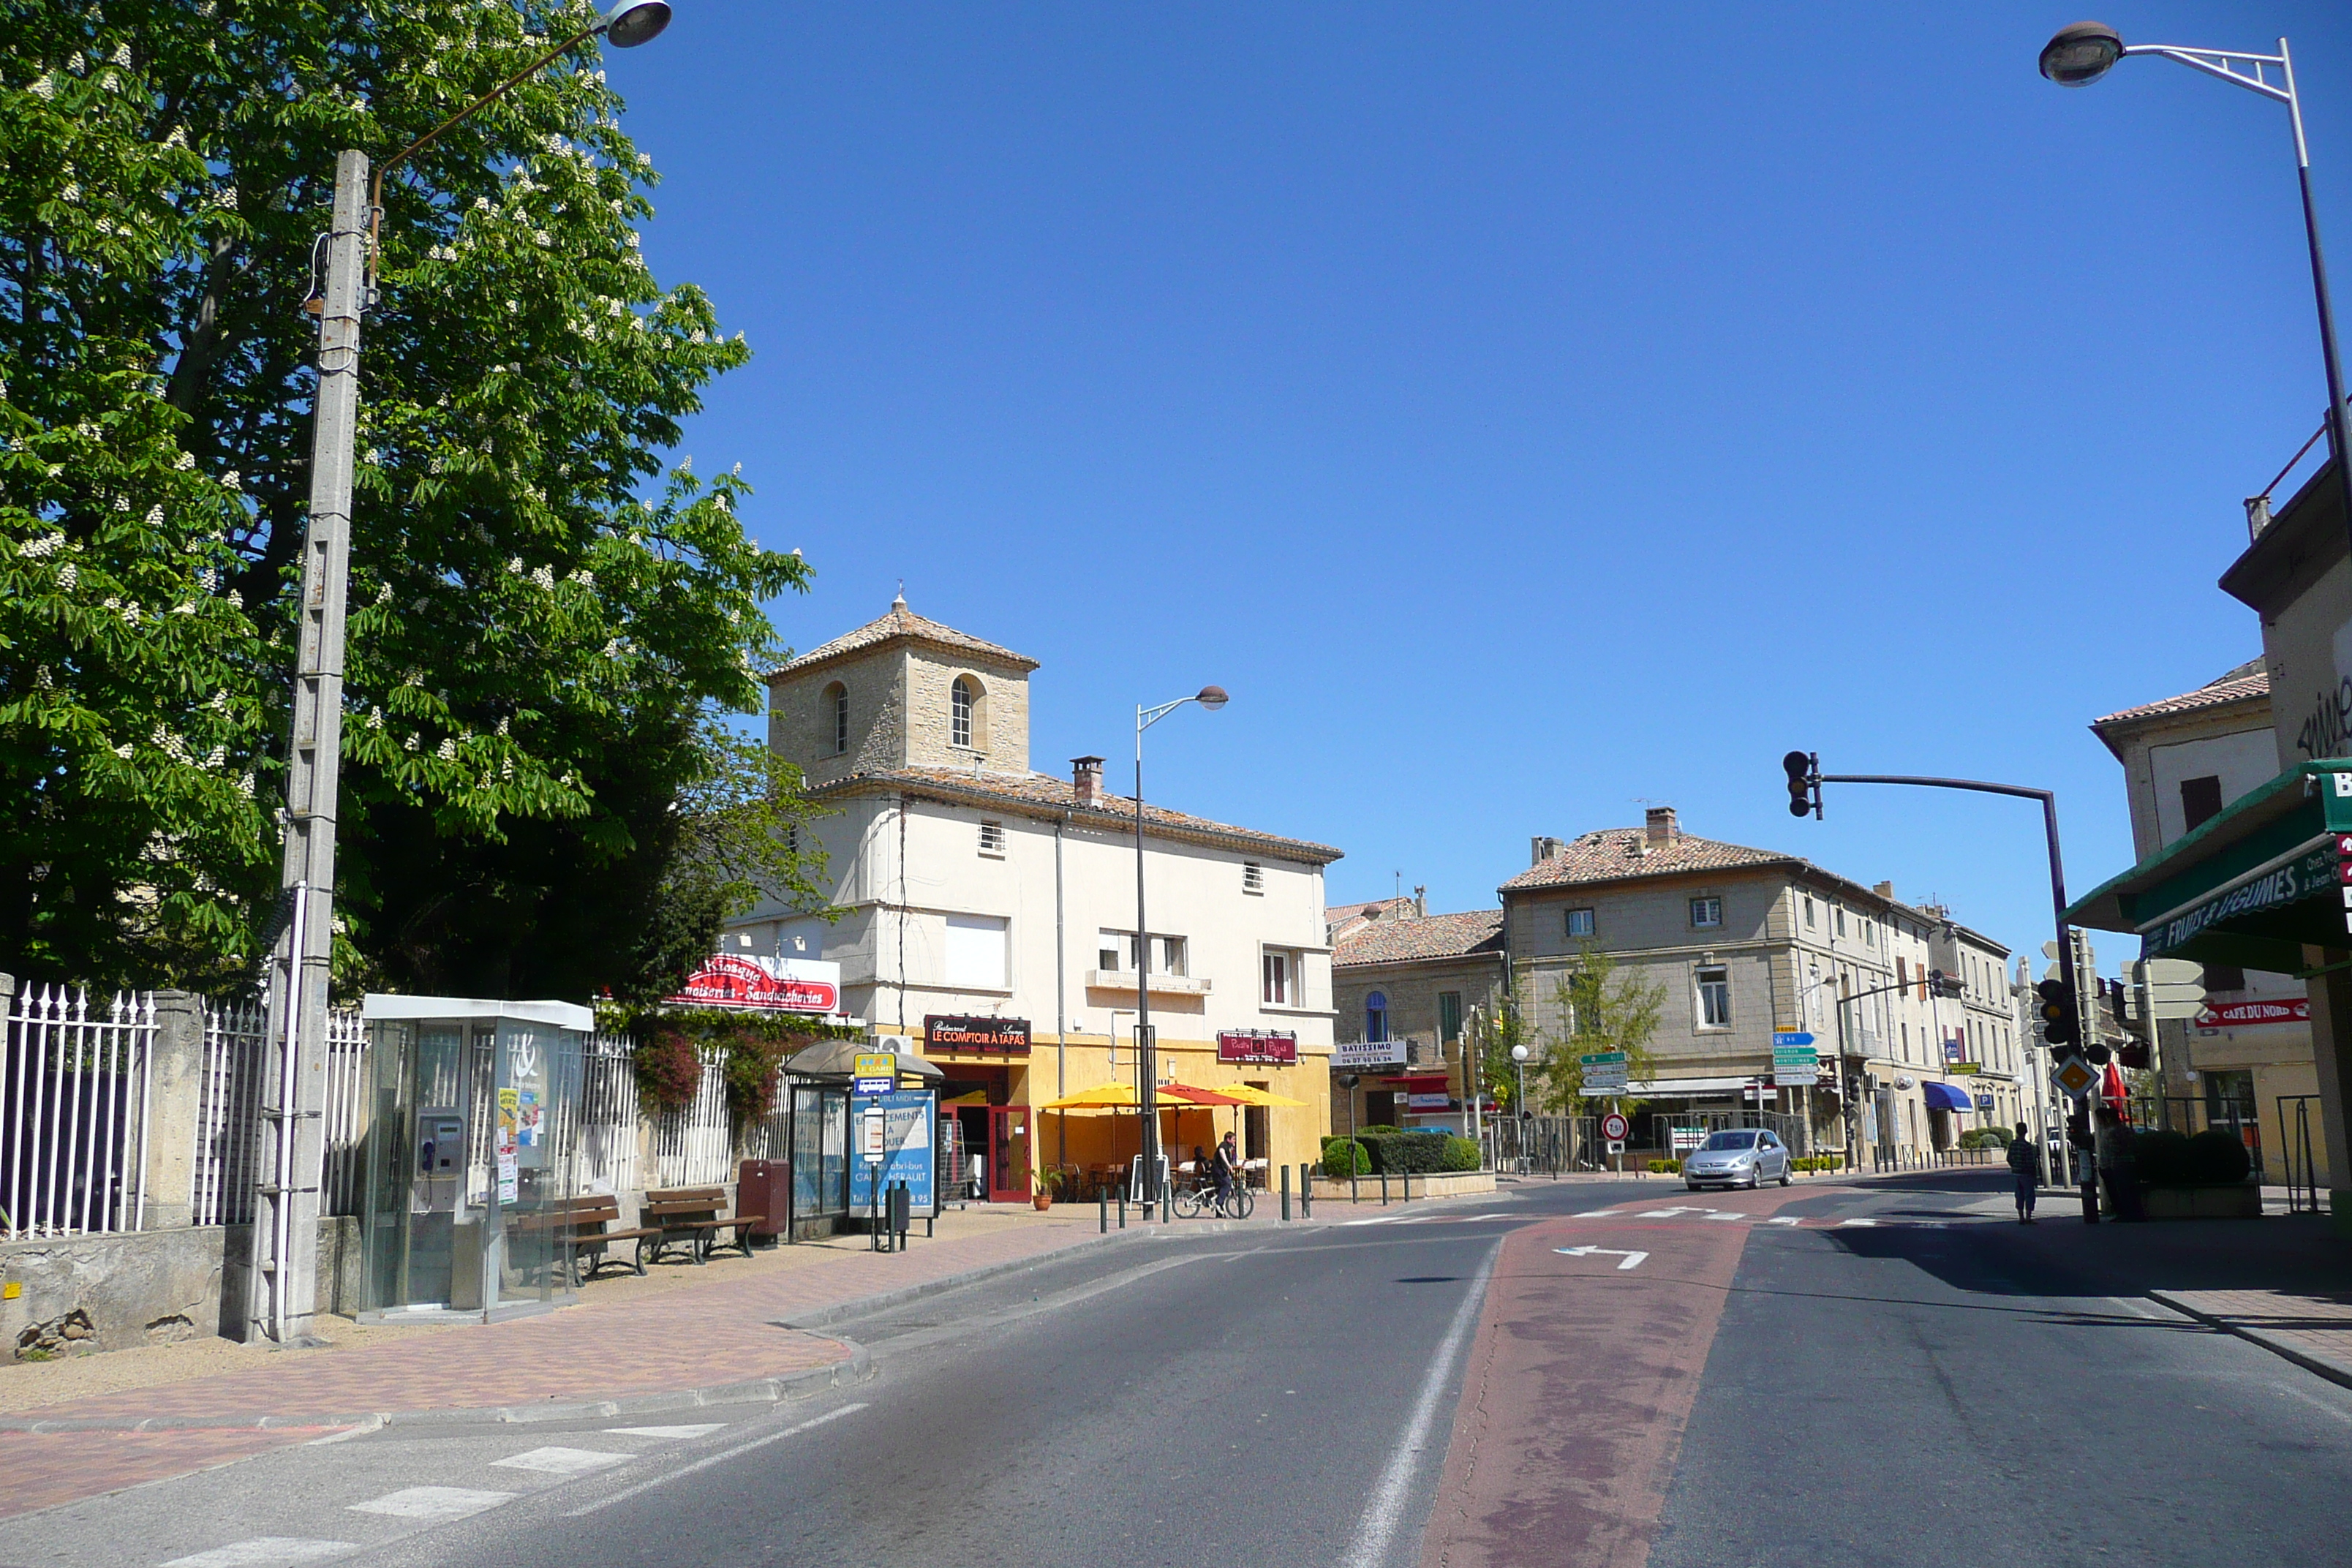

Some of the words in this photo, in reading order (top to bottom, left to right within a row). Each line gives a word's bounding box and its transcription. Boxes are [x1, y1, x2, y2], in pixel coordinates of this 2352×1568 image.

[2168, 905, 2206, 947] FRUITS
[704, 959, 762, 981] Kiosque
[745, 984, 823, 1005] Sandwicheries
[2247, 1005, 2261, 1019] DU
[2262, 1005, 2291, 1018] NORD
[932, 1030, 942, 1041] LE
[943, 1032, 989, 1044] COMPTOIR
[999, 1033, 1025, 1045] TAPAS
[1341, 1043, 1392, 1052] BATISSIMO
[878, 1095, 894, 1103] UBLI
[884, 1136, 905, 1147] OUER
